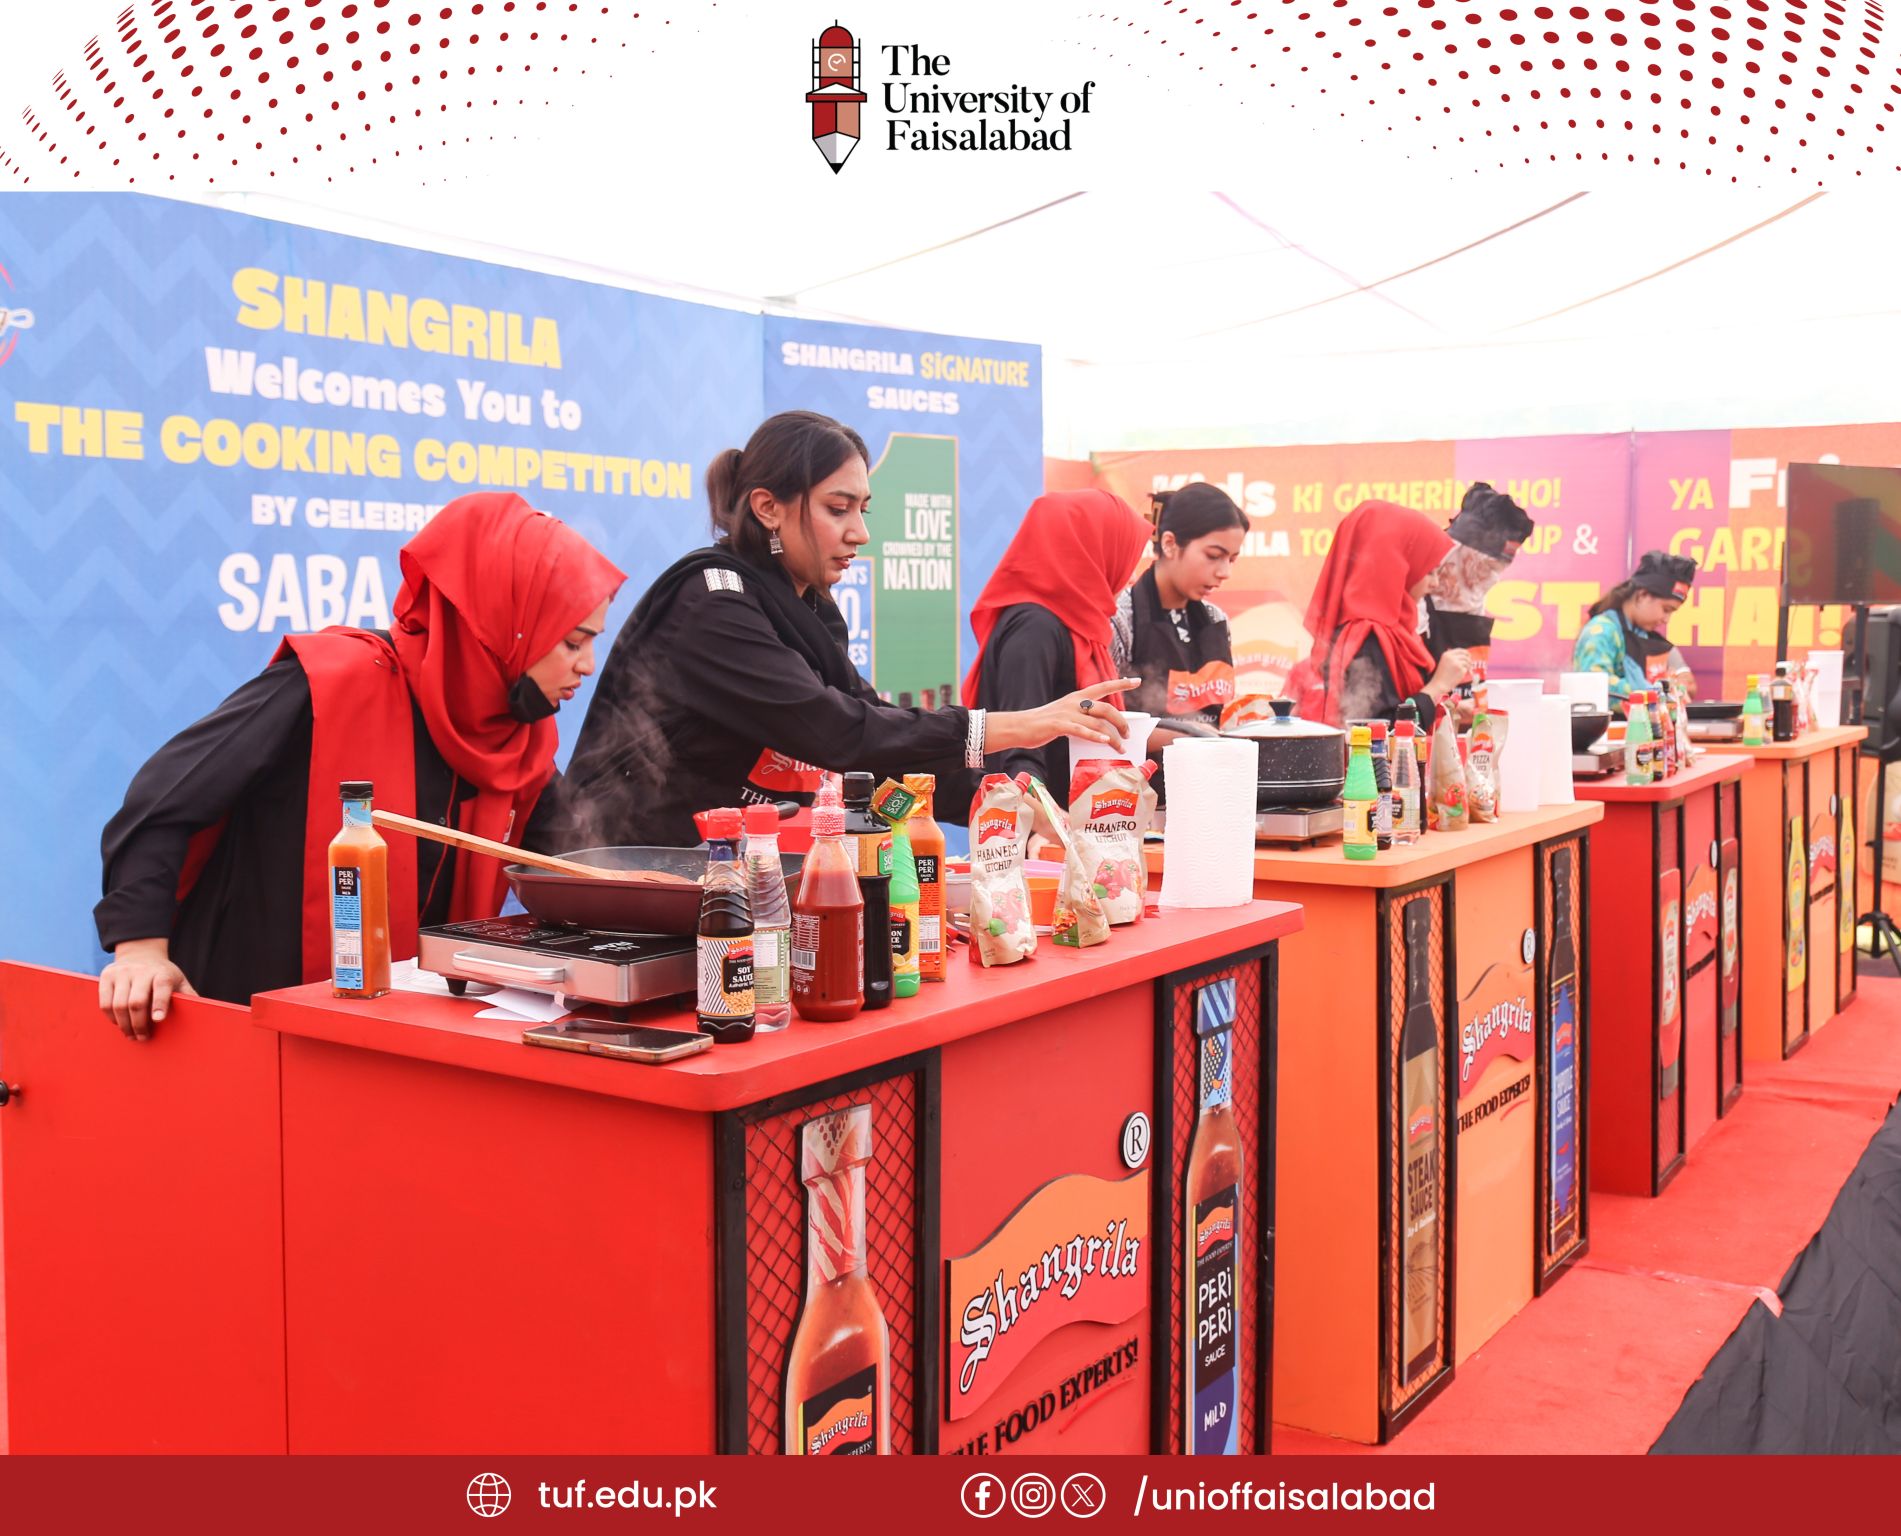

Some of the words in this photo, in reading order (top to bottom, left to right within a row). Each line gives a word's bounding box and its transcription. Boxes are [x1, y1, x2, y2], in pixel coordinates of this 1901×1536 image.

[232, 267, 562, 370] SHANGRILA
[781, 341, 914, 376] SHANGRILA
[204, 346, 446, 417] Welcomes
[456, 379, 531, 426] You
[541, 388, 581, 431] to
[867, 386, 960, 415] SAUCES
[15, 402, 144, 460] THE
[160, 414, 402, 479] COOKING
[414, 439, 693, 499] COMPETITION
[1508, 477, 1562, 508] HO!
[1669, 477, 1714, 511] YA
[251, 494, 297, 527] BY
[905, 508, 952, 541] LOVE
[1573, 524, 1598, 555] &
[883, 558, 952, 591] NATION
[218, 552, 392, 634] SABA
[1084, 820, 1137, 834] HABANERO
[977, 844, 1019, 862] HABANERO
[737, 966, 752, 975] SOY
[1462, 996, 1533, 1081] Shangrila
[1474, 1095, 1498, 1127] FOOD
[1407, 1149, 1436, 1196] STEAK
[1410, 1184, 1433, 1221] SAUCE
[959, 1218, 1140, 1394] Shangrila
[1205, 1343, 1226, 1366] SAUCE
[994, 1391, 1055, 1452] FOOD
[1060, 1336, 1139, 1411] EXPERTS!
[811, 1411, 868, 1455] Shangrila
[1204, 1402, 1227, 1432] MILD
